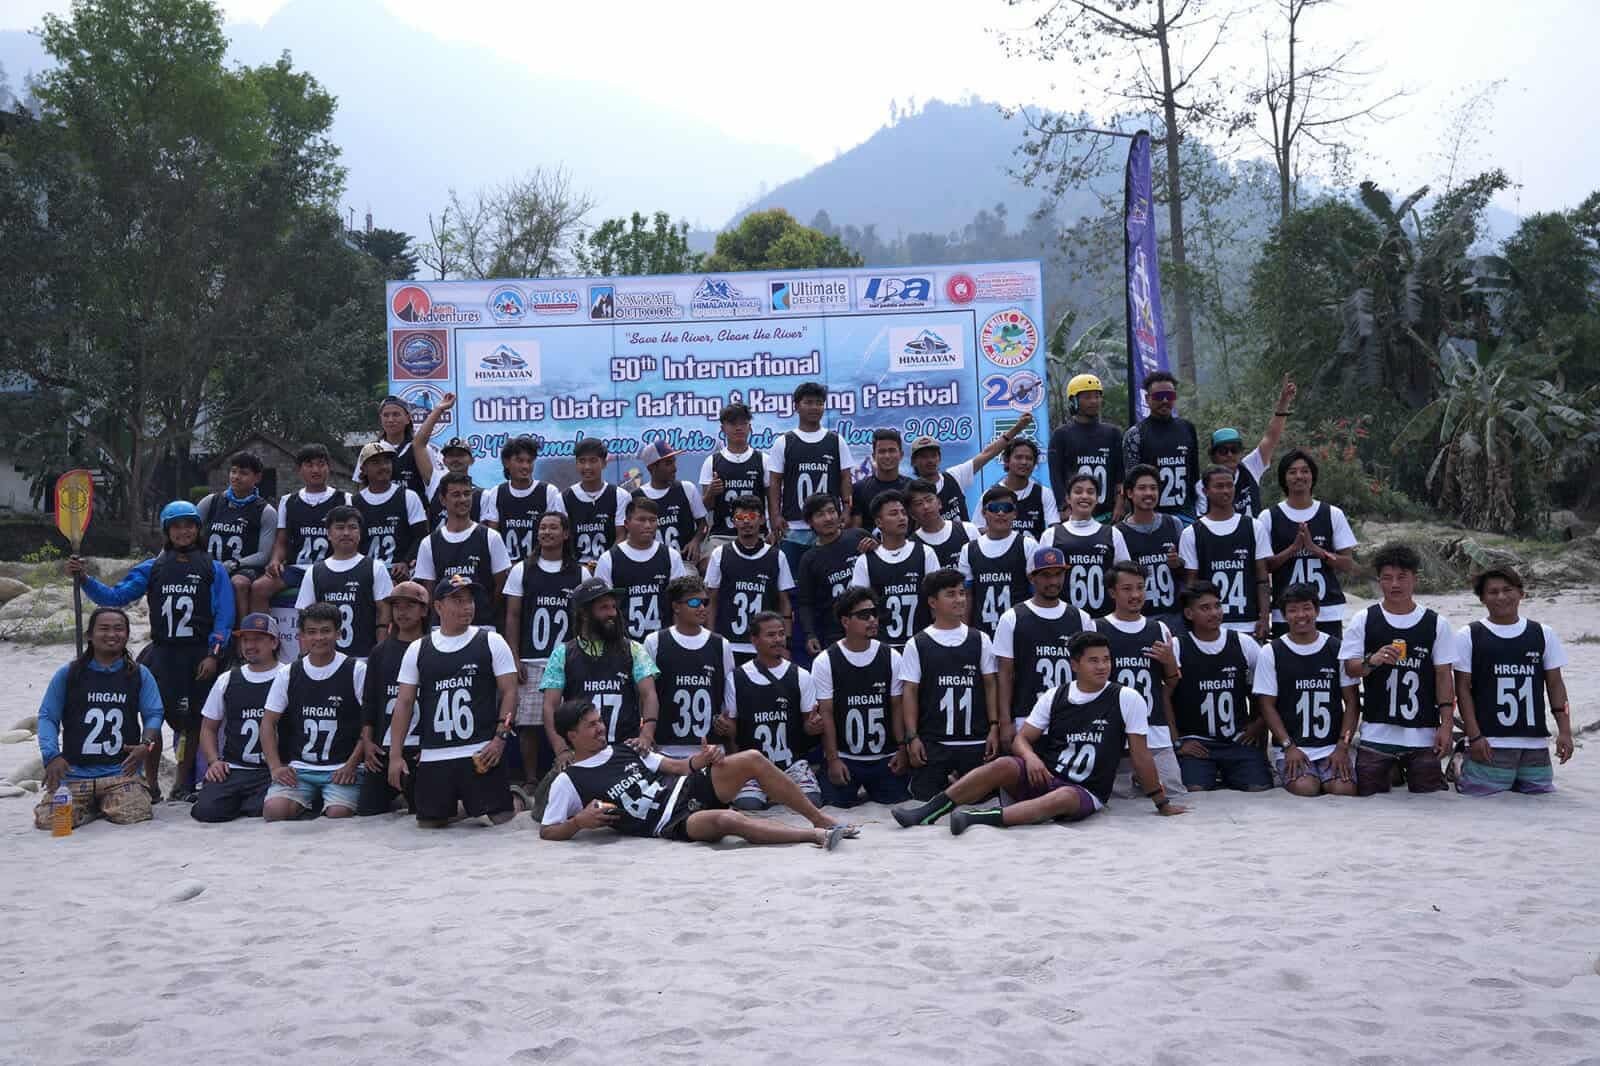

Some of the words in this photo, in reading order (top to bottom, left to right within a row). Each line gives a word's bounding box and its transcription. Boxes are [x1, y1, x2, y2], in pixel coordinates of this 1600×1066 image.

[791, 280, 846, 297] Ultimate
[792, 296, 847, 305] DESCENTS
[661, 331, 679, 344] the
[717, 329, 750, 342] Clean
[753, 328, 771, 341] the
[899, 354, 956, 365] HIMALAYAN
[611, 355, 656, 382] 50th
[663, 350, 820, 381] International
[475, 370, 533, 379] HIMALAYAN
[473, 396, 544, 422] White
[551, 393, 630, 420] Water
[636, 391, 722, 421] Rafting
[749, 389, 855, 416] Kayng
[862, 382, 958, 409] Festival
[904, 417, 974, 443] 2026
[1077, 456, 1106, 465] HRGAN
[1157, 456, 1185, 466] HRGAN
[799, 463, 828, 471] HRGAN
[725, 479, 754, 489] HRGAN
[1159, 466, 1187, 507] 25
[652, 514, 678, 526] RGAN
[211, 522, 243, 535] HRGAN
[577, 523, 605, 534] HRGAN
[1069, 554, 1103, 564] HRGAN
[1211, 560, 1244, 570] HRGAN
[827, 567, 855, 585] HRGA
[979, 573, 1013, 583] HRGAN
[162, 584, 197, 595] HRGAN
[629, 584, 660, 595] HRGAN
[736, 581, 765, 593] HRGAN
[884, 584, 917, 596] HRGAN
[1070, 564, 1105, 609] 60
[1144, 563, 1174, 607] 49
[325, 592, 356, 602] HRGAN
[1211, 571, 1247, 615] 24
[537, 596, 568, 607] HRGAN
[161, 596, 195, 638] 12
[628, 595, 662, 639] 54
[886, 594, 918, 638] 37
[532, 607, 569, 650] 02
[1036, 646, 1071, 657] HRGAN
[1494, 664, 1535, 675] HRGAN
[435, 677, 473, 691] HRGAN
[676, 675, 711, 687] HRGAN
[938, 675, 974, 686] HRGAN
[1036, 658, 1072, 698] 30
[1295, 679, 1331, 689] HRGAN
[584, 680, 621, 691] HRGAN
[1199, 679, 1235, 691] HRGAN
[87, 692, 127, 704] HRGAN
[848, 694, 883, 706] HRGAN
[1386, 668, 1420, 721] 13
[1496, 677, 1536, 727] 51
[242, 708, 265, 719] HRG
[303, 706, 337, 718] HRGAN
[433, 689, 474, 741] 46
[672, 689, 712, 738] 39
[754, 711, 788, 723] HRGAN
[940, 687, 972, 736] 11
[1200, 691, 1236, 738] 19
[1296, 691, 1331, 739] 15
[82, 707, 125, 756] 23
[845, 707, 887, 755] 05
[240, 719, 265, 764] 2
[302, 719, 338, 762] 27
